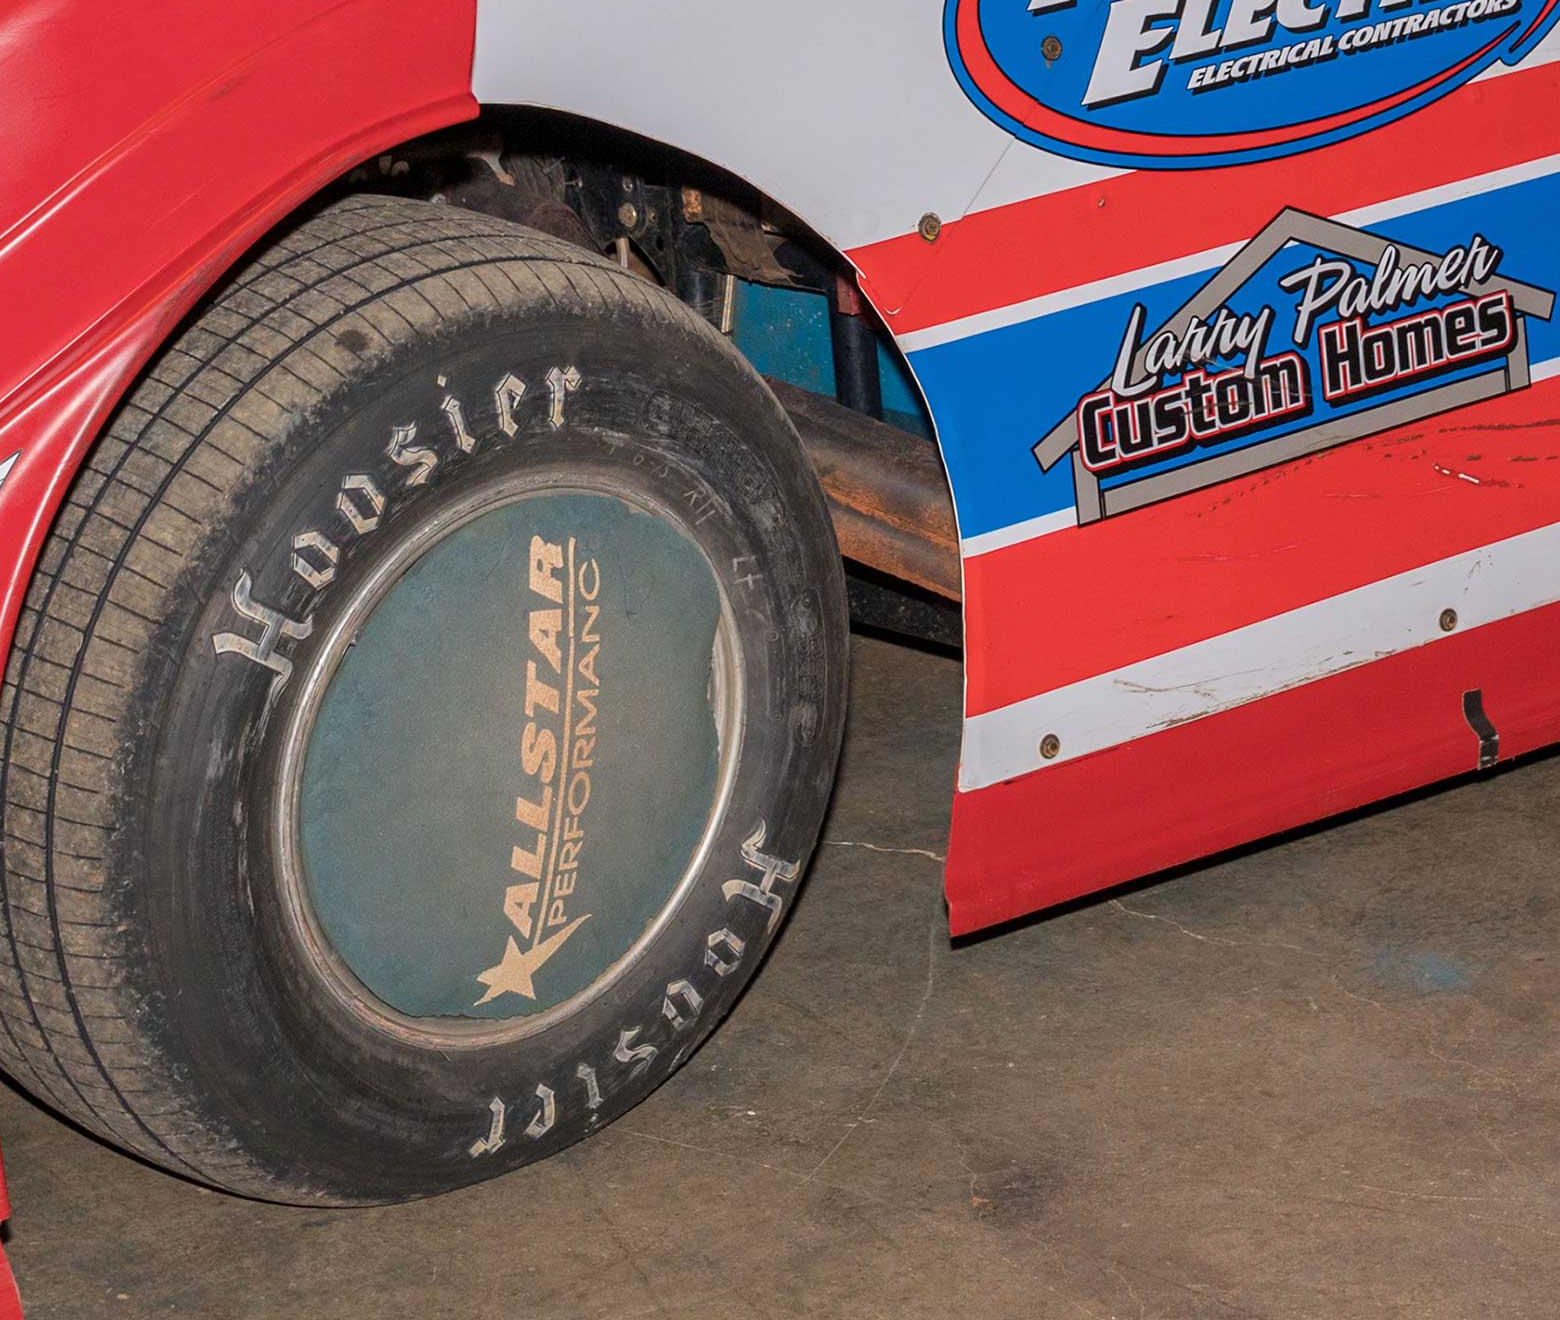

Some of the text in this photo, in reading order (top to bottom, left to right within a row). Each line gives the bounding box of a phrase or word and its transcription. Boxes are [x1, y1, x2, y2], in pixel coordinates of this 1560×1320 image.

[1187, 36, 1334, 91] ELECTRICAL
[1078, 292, 1510, 470] Custom Homes
[1111, 234, 1500, 392] Larry Palmer
[212, 362, 582, 698] Hoosier
[504, 534, 566, 938] ALLSTAR
[470, 817, 802, 1160] Hoosier
